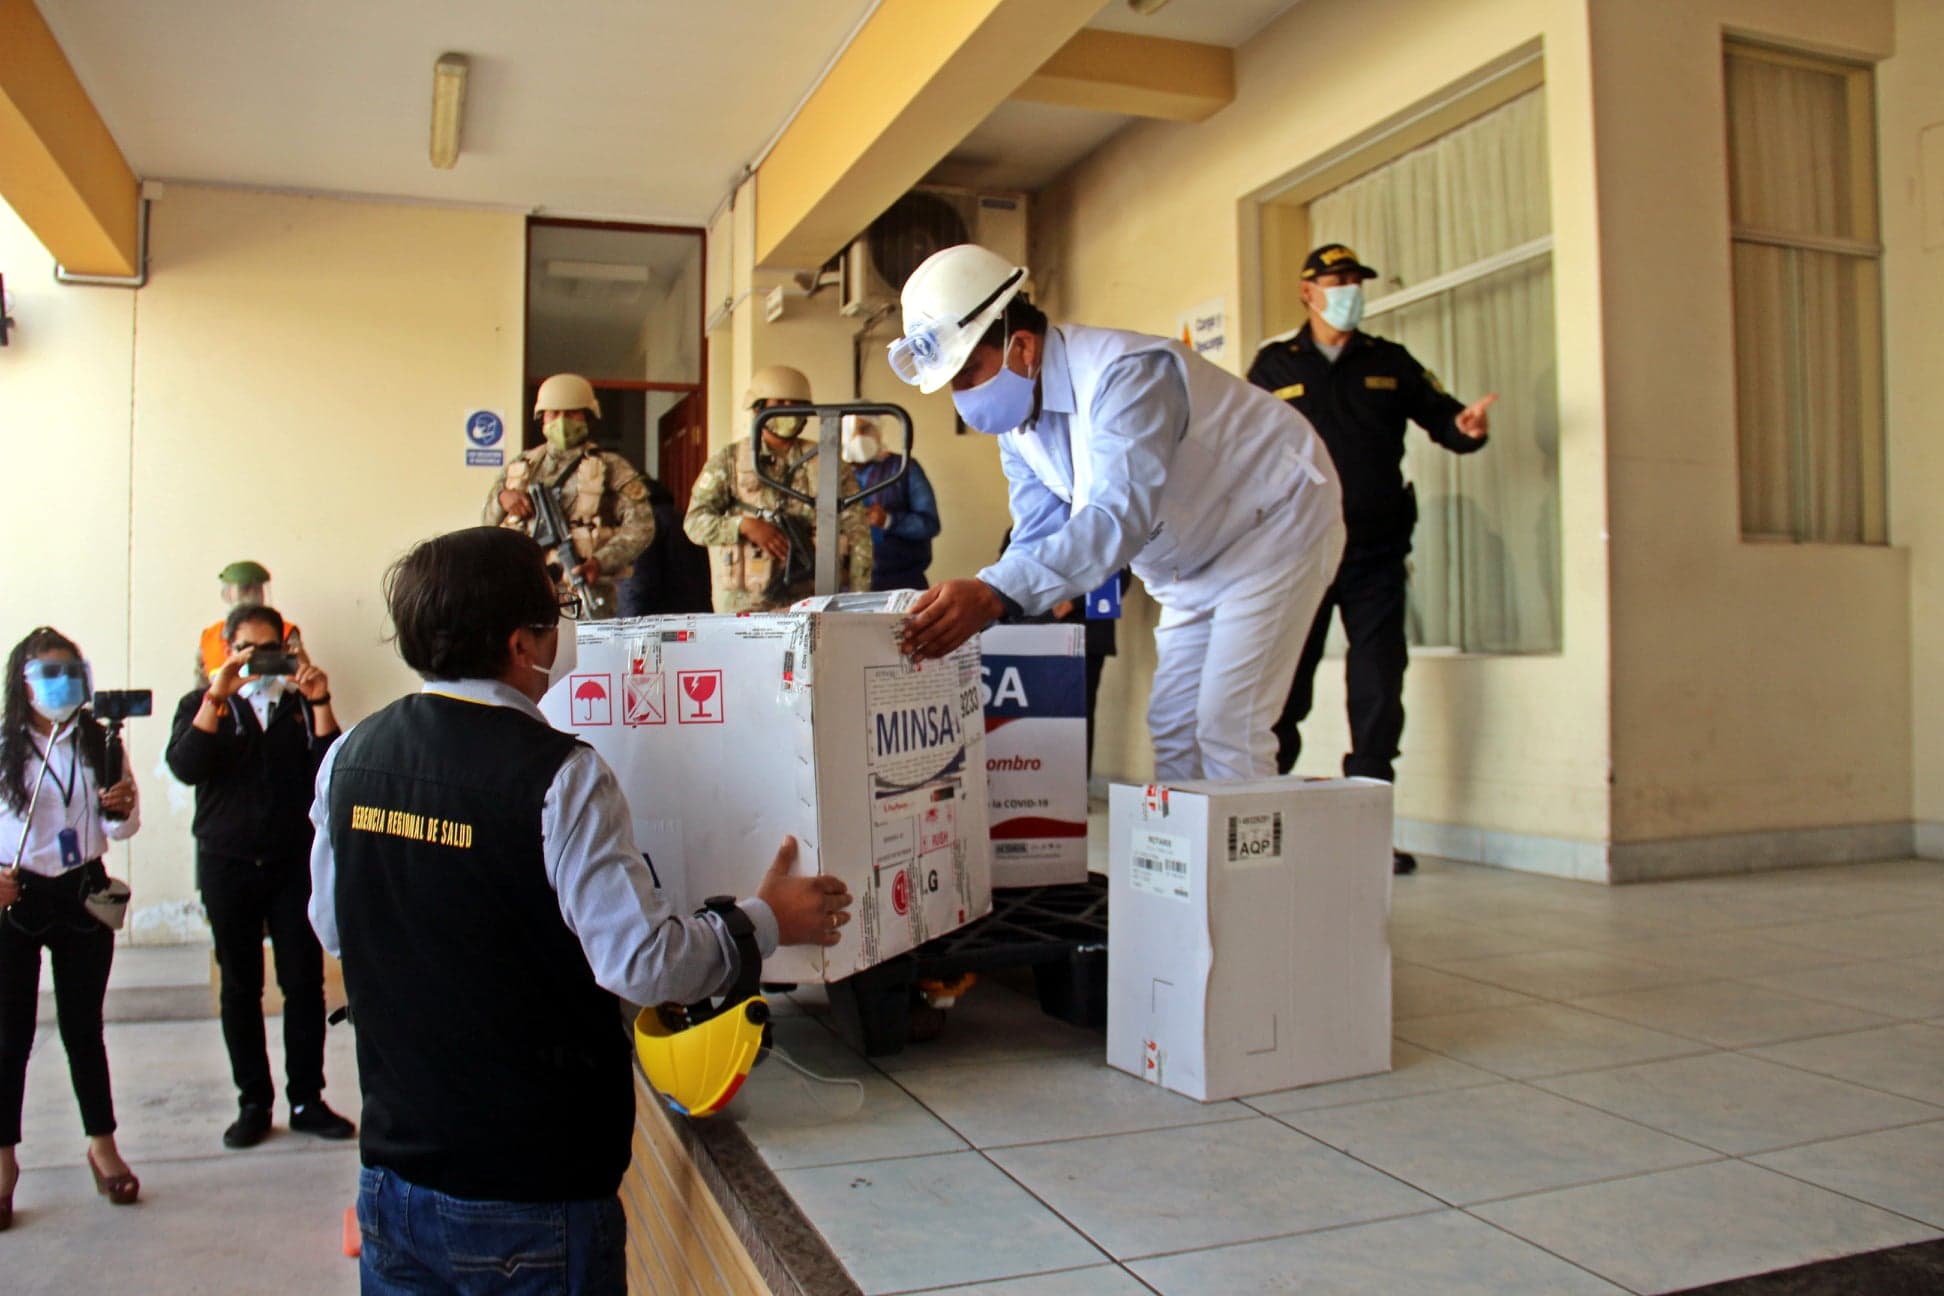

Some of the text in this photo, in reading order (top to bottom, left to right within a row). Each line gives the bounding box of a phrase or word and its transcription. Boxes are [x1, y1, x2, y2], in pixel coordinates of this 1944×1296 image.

[876, 704, 954, 757] MINSA
[1004, 799, 1049, 808] COVID-19
[352, 805, 473, 849] GERENCIA REGIONAL DE SALUD
[1240, 840, 1270, 857] AQP
